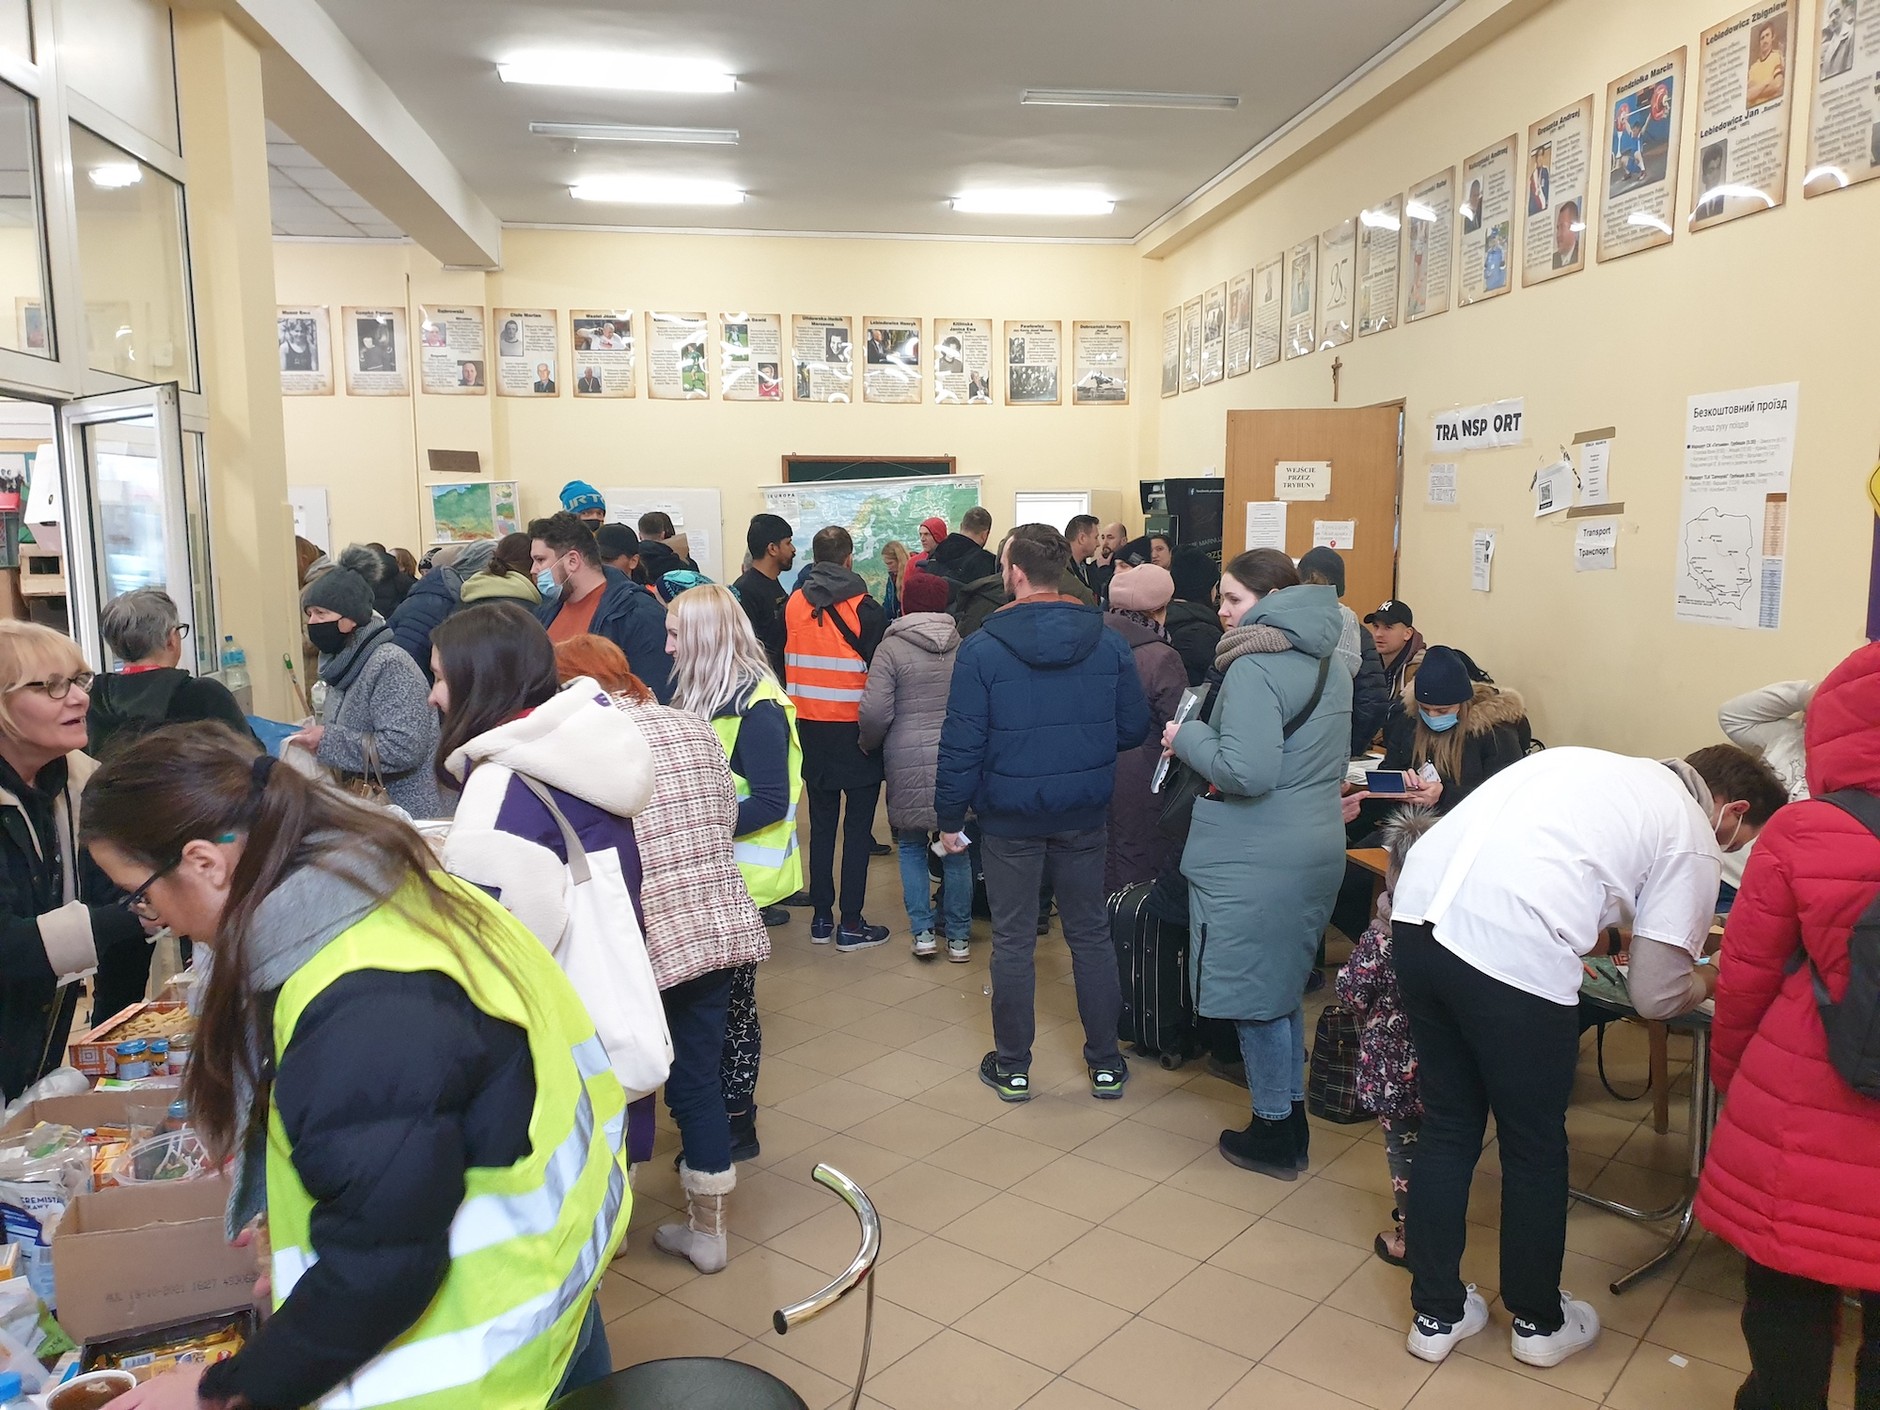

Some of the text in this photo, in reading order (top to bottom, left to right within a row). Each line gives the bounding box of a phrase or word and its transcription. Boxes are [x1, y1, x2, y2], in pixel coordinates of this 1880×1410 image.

[1700, 114, 1742, 138] Lebiedowicz
[1744, 108, 1760, 119] Jan
[1693, 398, 1787, 418] Безкоштовний проїзд
[1583, 527, 1611, 537] Transport
[1579, 547, 1609, 558] Транспорт
[1417, 1315, 1440, 1331] FILA
[1514, 1317, 1537, 1331] FILA
